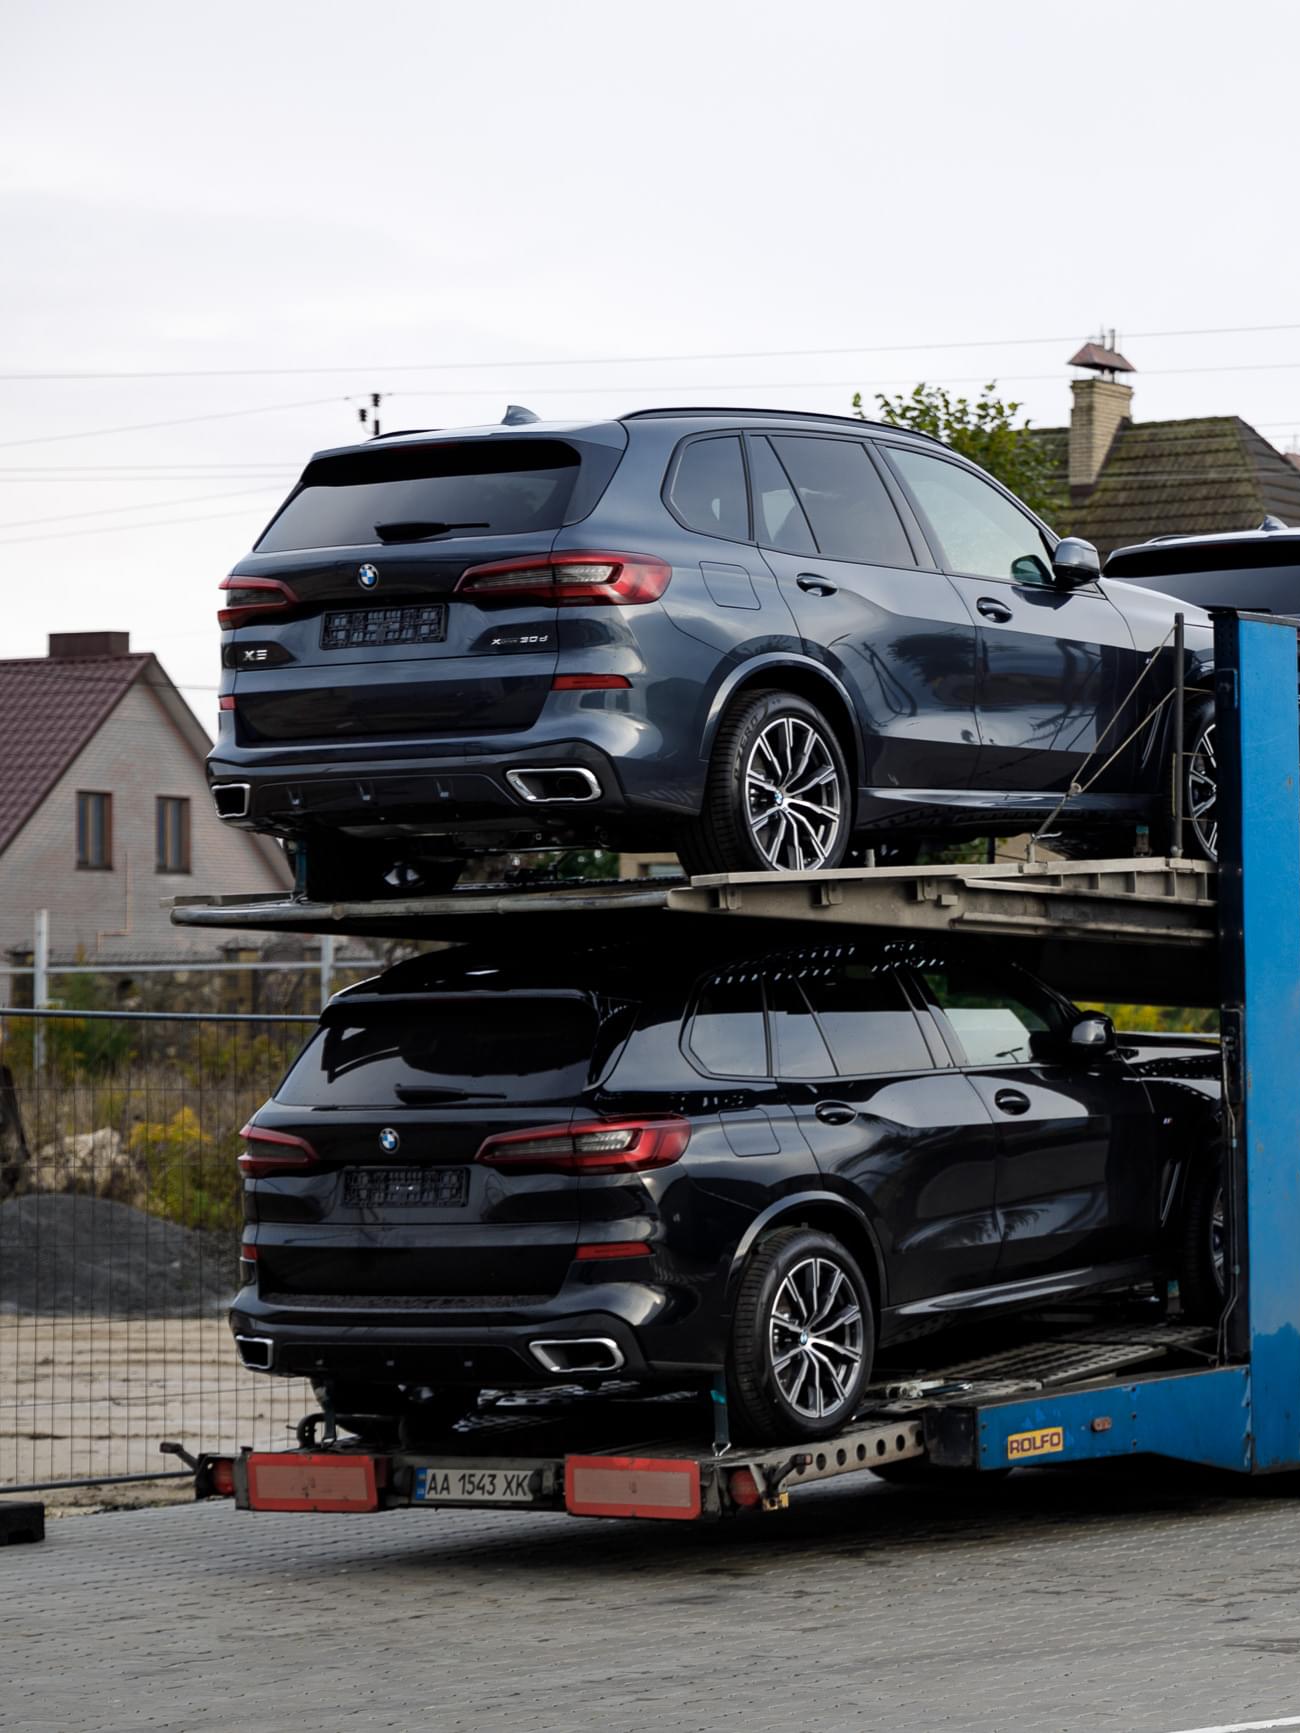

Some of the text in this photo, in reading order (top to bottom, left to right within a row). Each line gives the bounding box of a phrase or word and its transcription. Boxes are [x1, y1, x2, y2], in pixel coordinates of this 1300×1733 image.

[1009, 1431, 1062, 1456] ROLFO
[426, 1472, 529, 1497] AA 1543 XK
